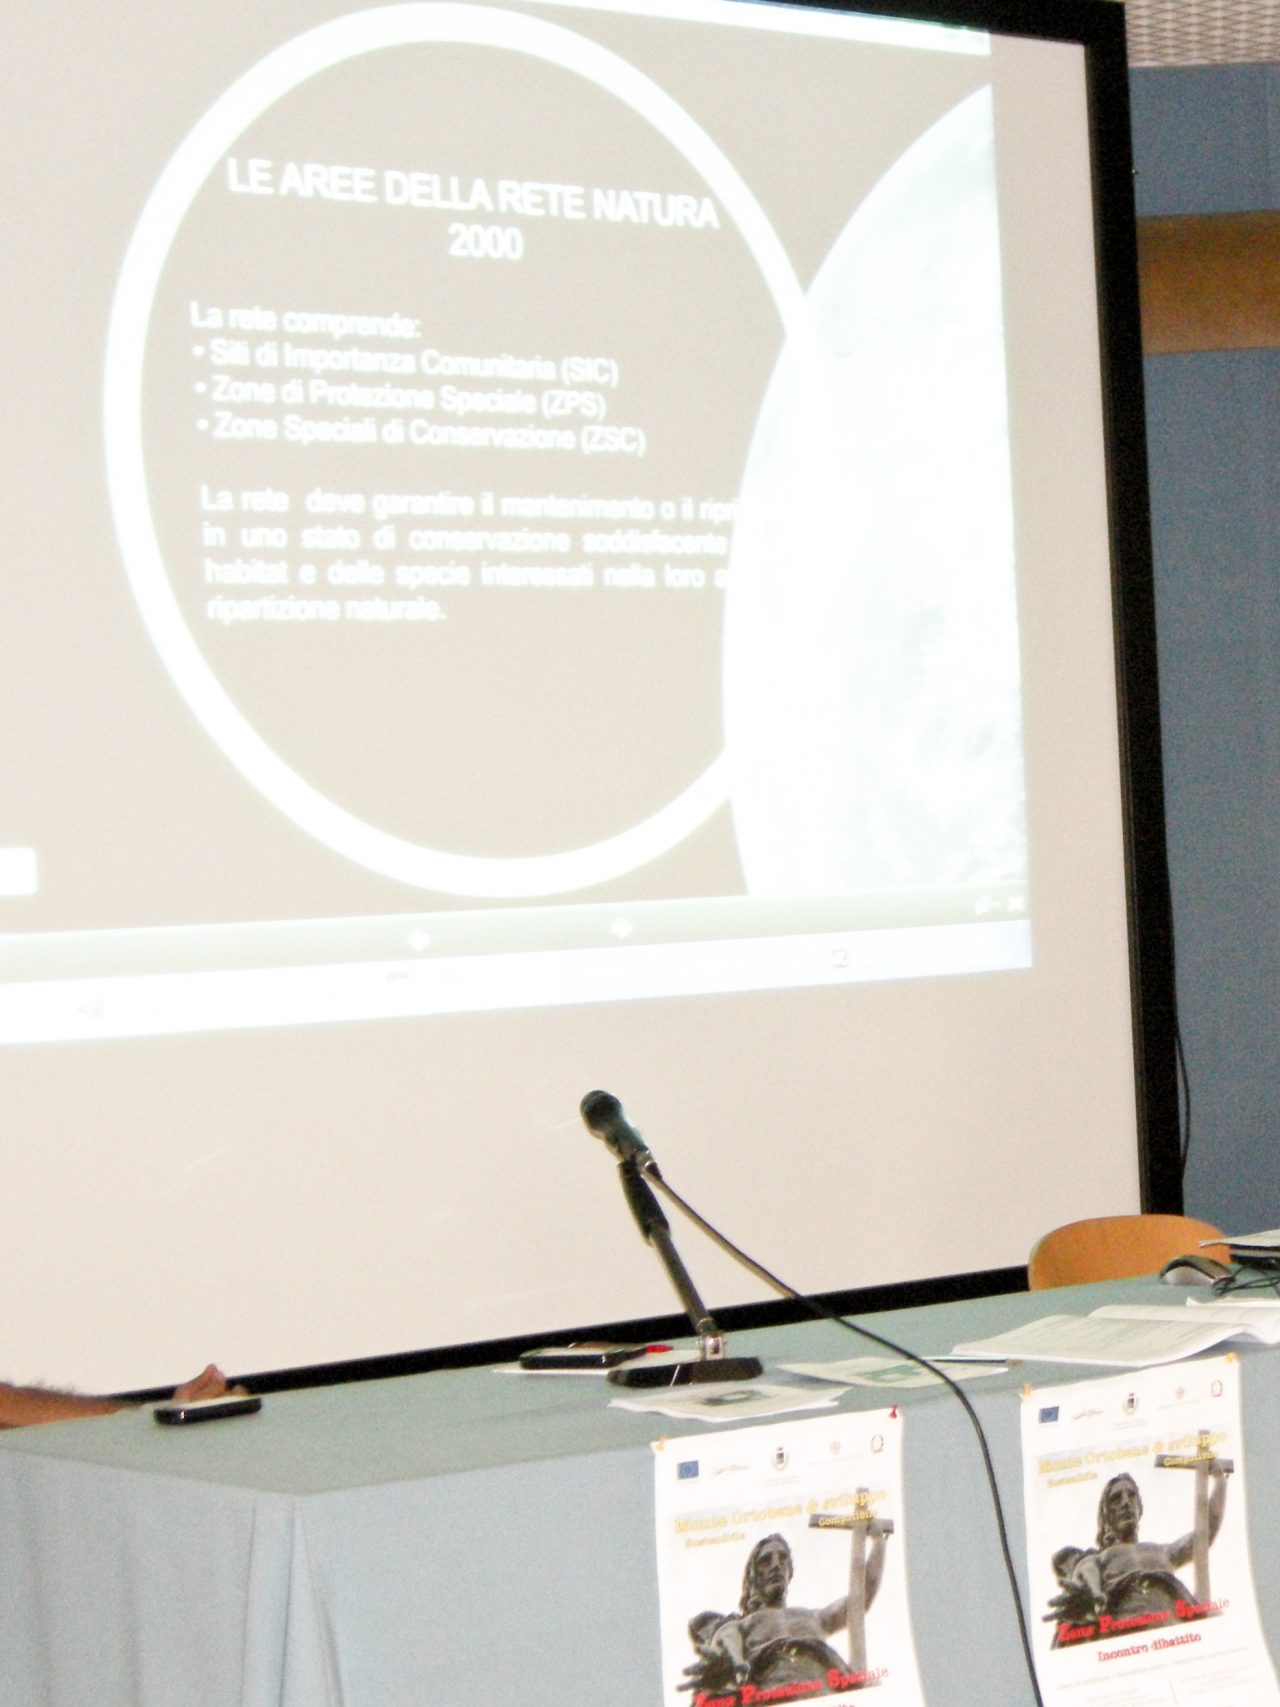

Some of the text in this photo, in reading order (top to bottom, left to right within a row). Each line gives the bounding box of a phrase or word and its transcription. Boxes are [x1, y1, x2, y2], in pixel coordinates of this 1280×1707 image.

[228, 158, 720, 229] LE AREE DELLA RETE NATURA
[449, 221, 525, 260] 2000
[190, 301, 421, 340] La rete comprende:
[210, 338, 619, 388] Siti di Importanza Comunitaria (SIC)
[212, 375, 606, 422] Zone di Protezione Speciale (ZPS)
[214, 411, 647, 457] Zone Speciali di Conservazione (ZSC)
[201, 484, 234, 511] La
[241, 488, 290, 513] rete
[306, 488, 365, 514] deve
[373, 491, 475, 521] garantire
[661, 501, 676, 520] o
[203, 521, 227, 547] in
[241, 527, 289, 549] uno
[301, 525, 361, 550] stato
[374, 525, 396, 550] di
[409, 528, 571, 553] conservazione
[205, 558, 290, 584] habitat
[328, 559, 386, 585] delle
[207, 595, 340, 625] ripartizione
